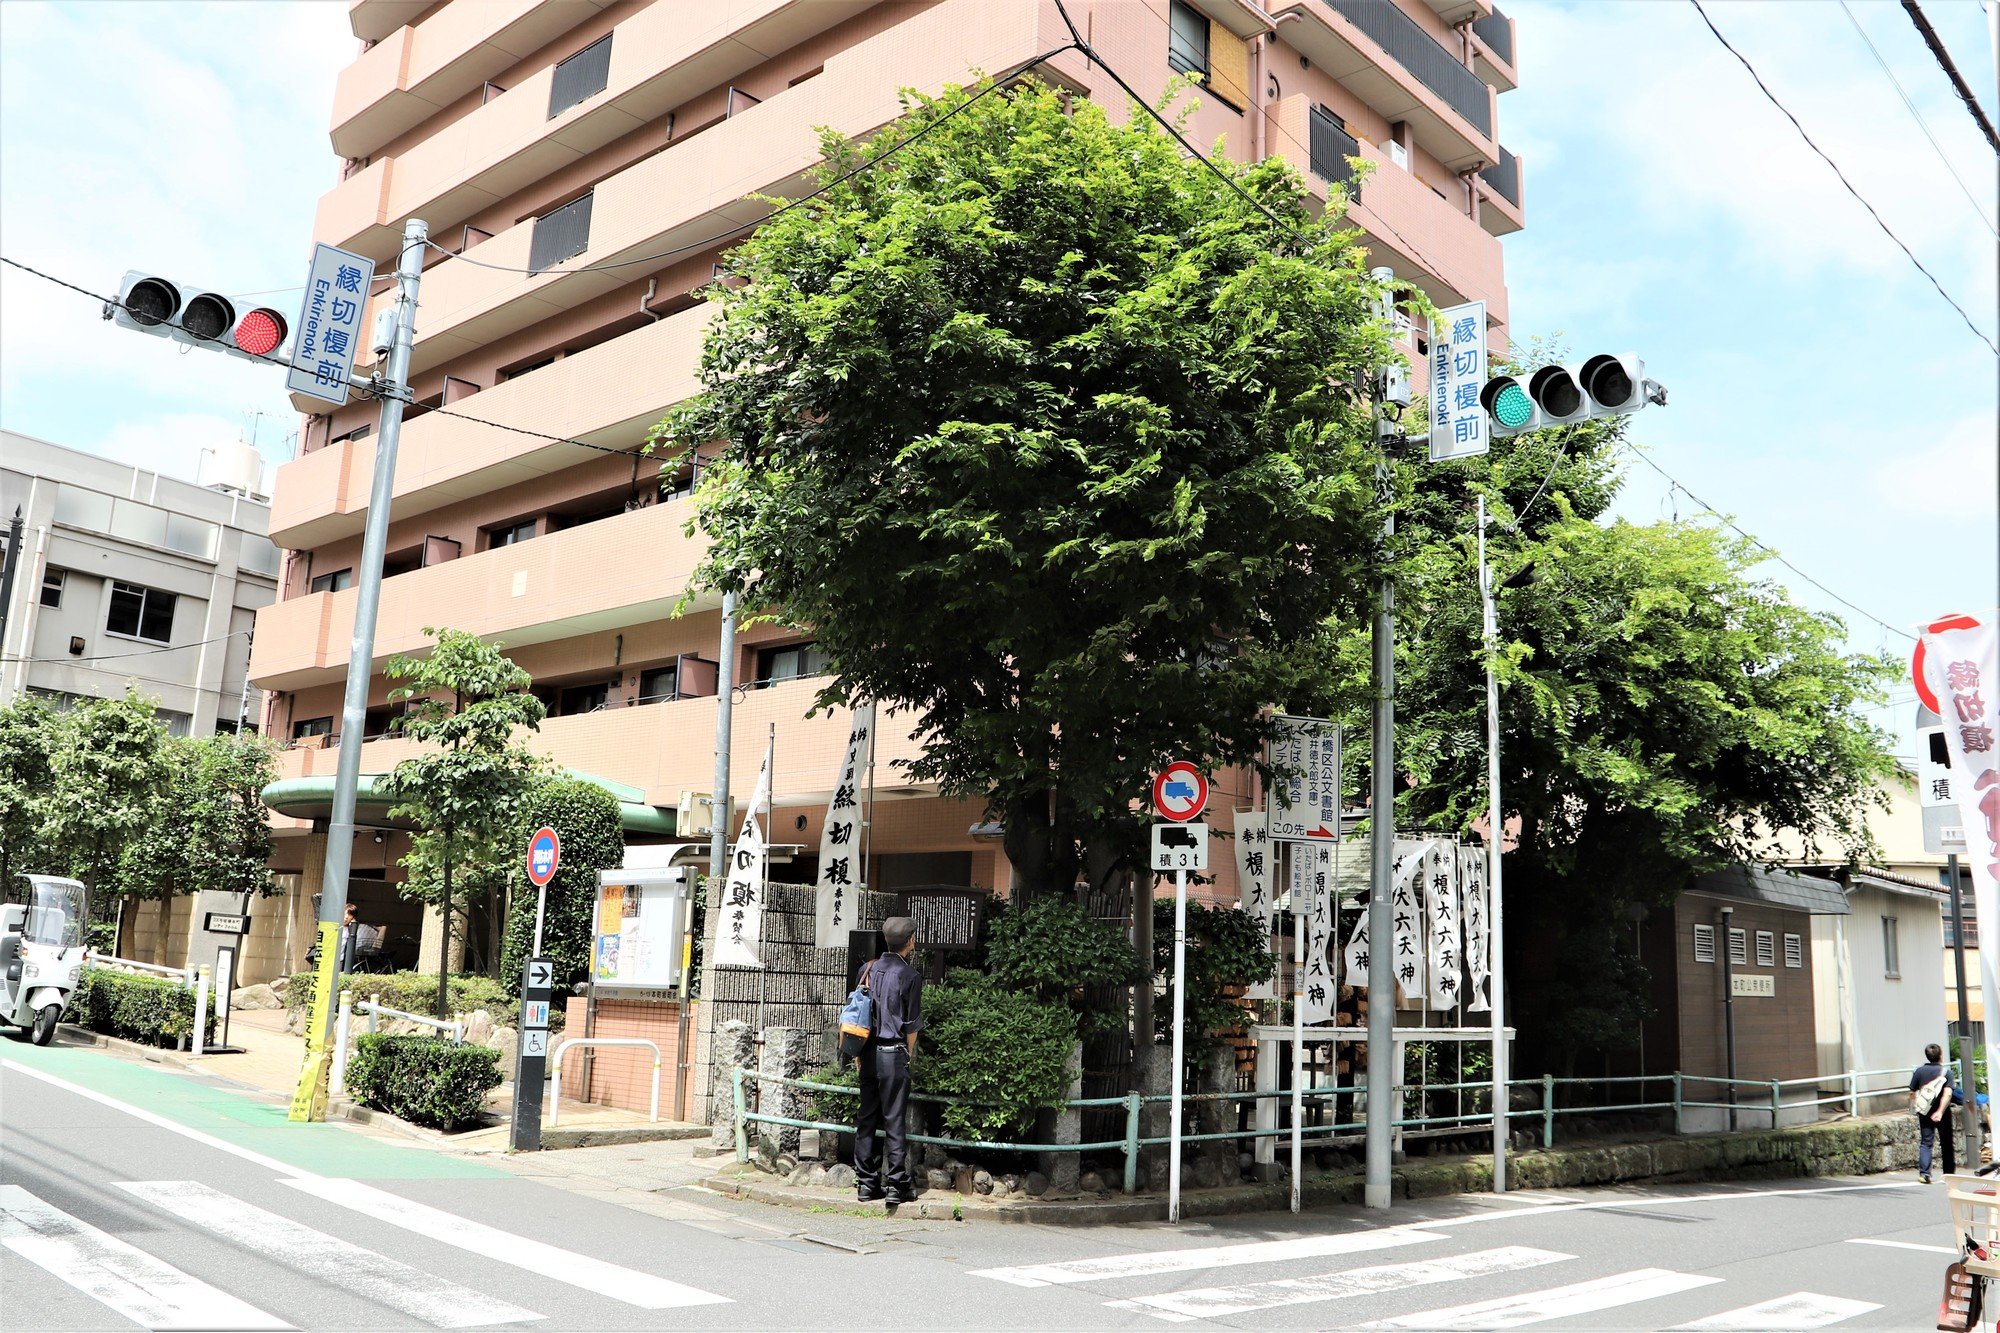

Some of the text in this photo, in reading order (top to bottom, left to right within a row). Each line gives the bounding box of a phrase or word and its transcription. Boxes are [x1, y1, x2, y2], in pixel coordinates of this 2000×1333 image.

[301, 278, 330, 360] Enkirienoki
[315, 264, 362, 389] 縁切榎前
[1437, 343, 1450, 426] Enkirienoki
[1452, 316, 1480, 443] 縁切榎前
[1242, 828, 1266, 844] 奉納
[1272, 821, 1305, 836] この先
[1433, 873, 1456, 996] 榎大六天神
